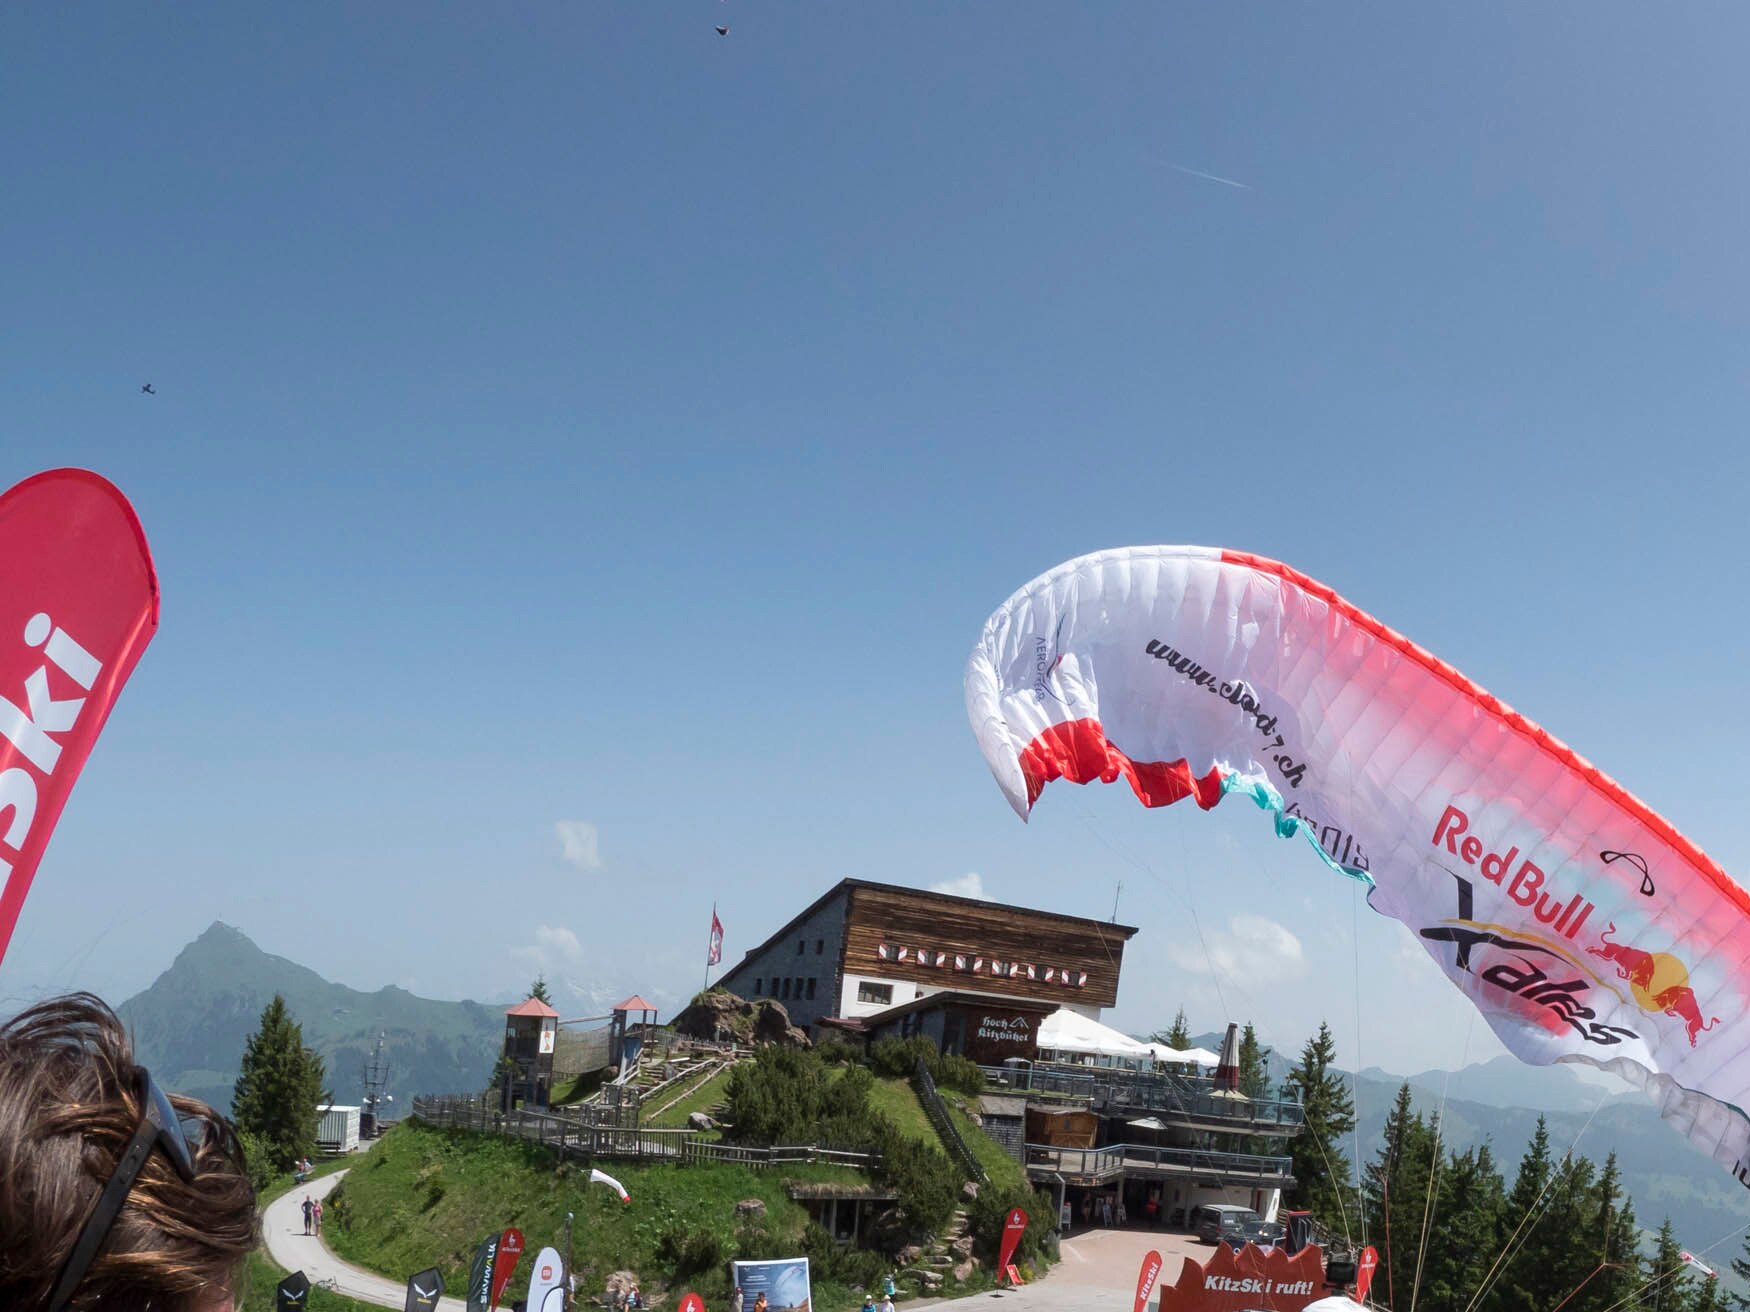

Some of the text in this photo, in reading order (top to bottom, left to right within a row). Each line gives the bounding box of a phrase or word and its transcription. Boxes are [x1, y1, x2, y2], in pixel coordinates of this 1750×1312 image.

[1432, 804, 1519, 887] Red
[1507, 859, 1595, 939] Bull
[480, 1242, 497, 1305] SKYWALK
[1204, 1275, 1314, 1295] KitzSki ruft!
